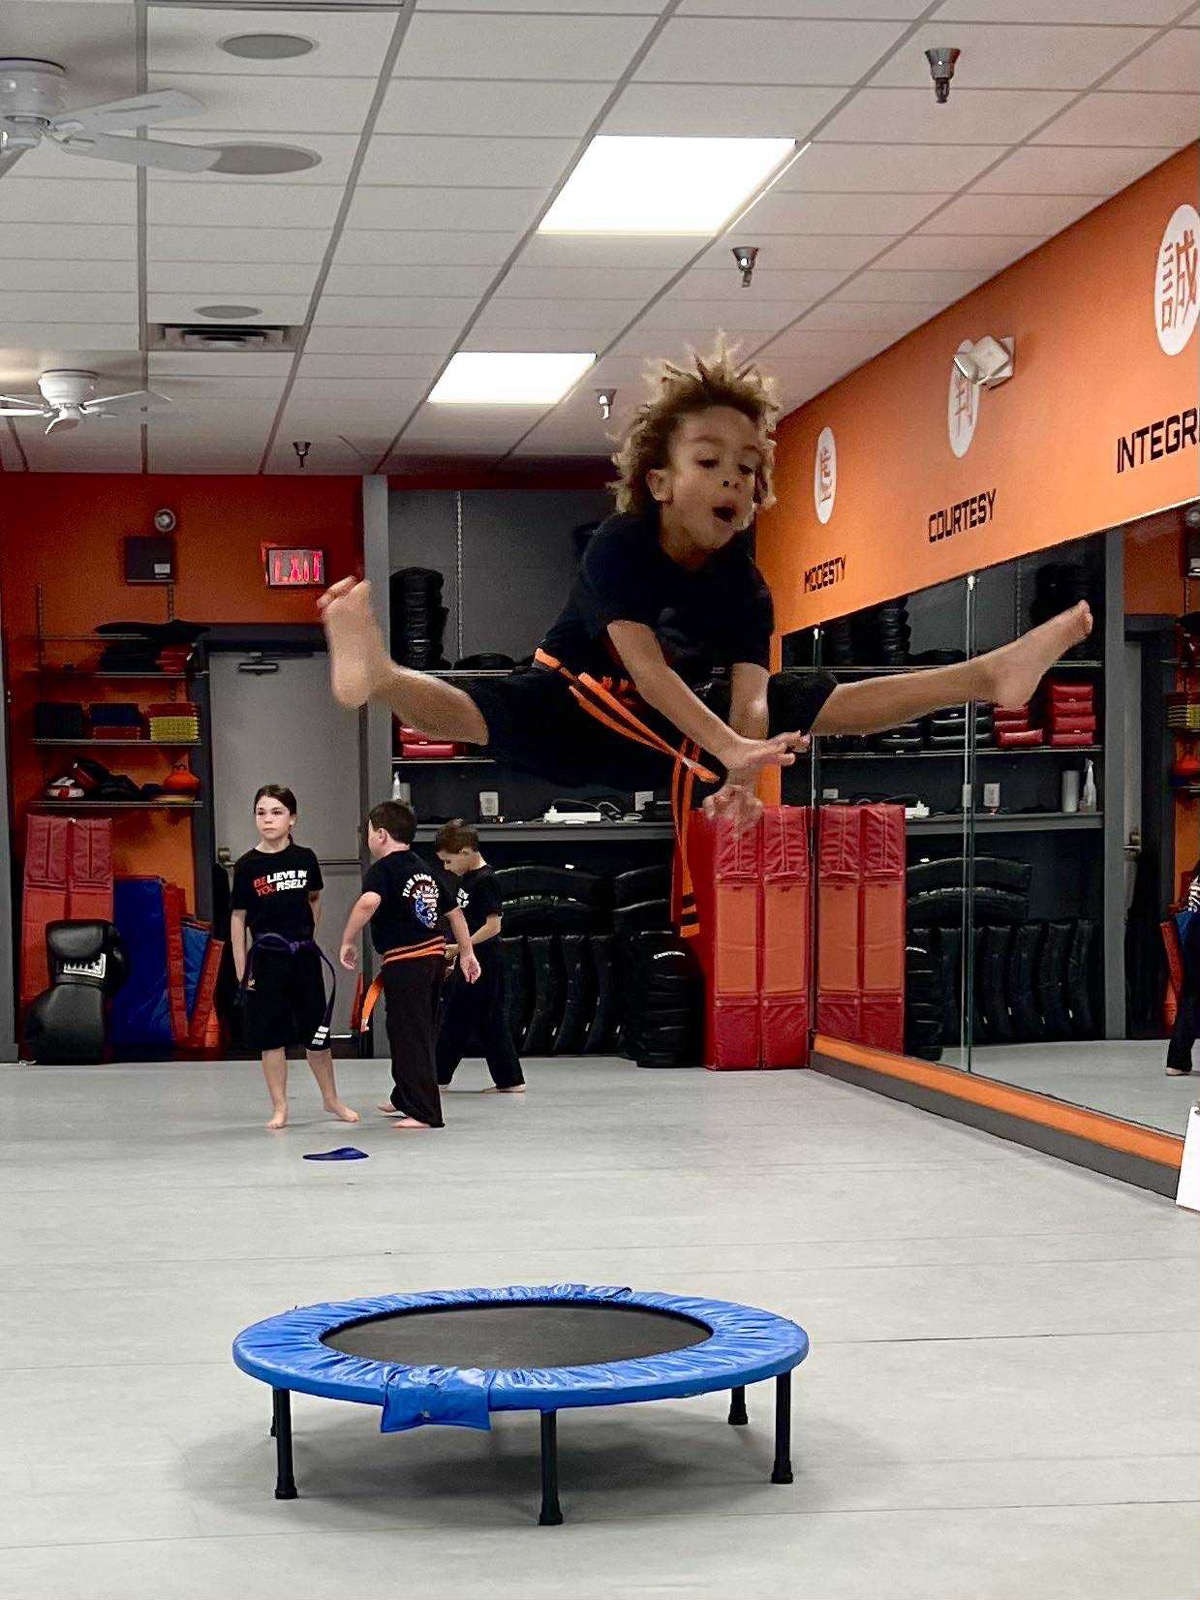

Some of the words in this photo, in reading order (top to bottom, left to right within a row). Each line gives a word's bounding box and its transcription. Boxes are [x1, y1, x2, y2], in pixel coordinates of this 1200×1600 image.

[1117, 407, 1200, 474] INTEGR
[928, 488, 997, 544] COURTESY
[804, 555, 846, 594] MODESTY
[254, 870, 296, 888] BELIEVE
